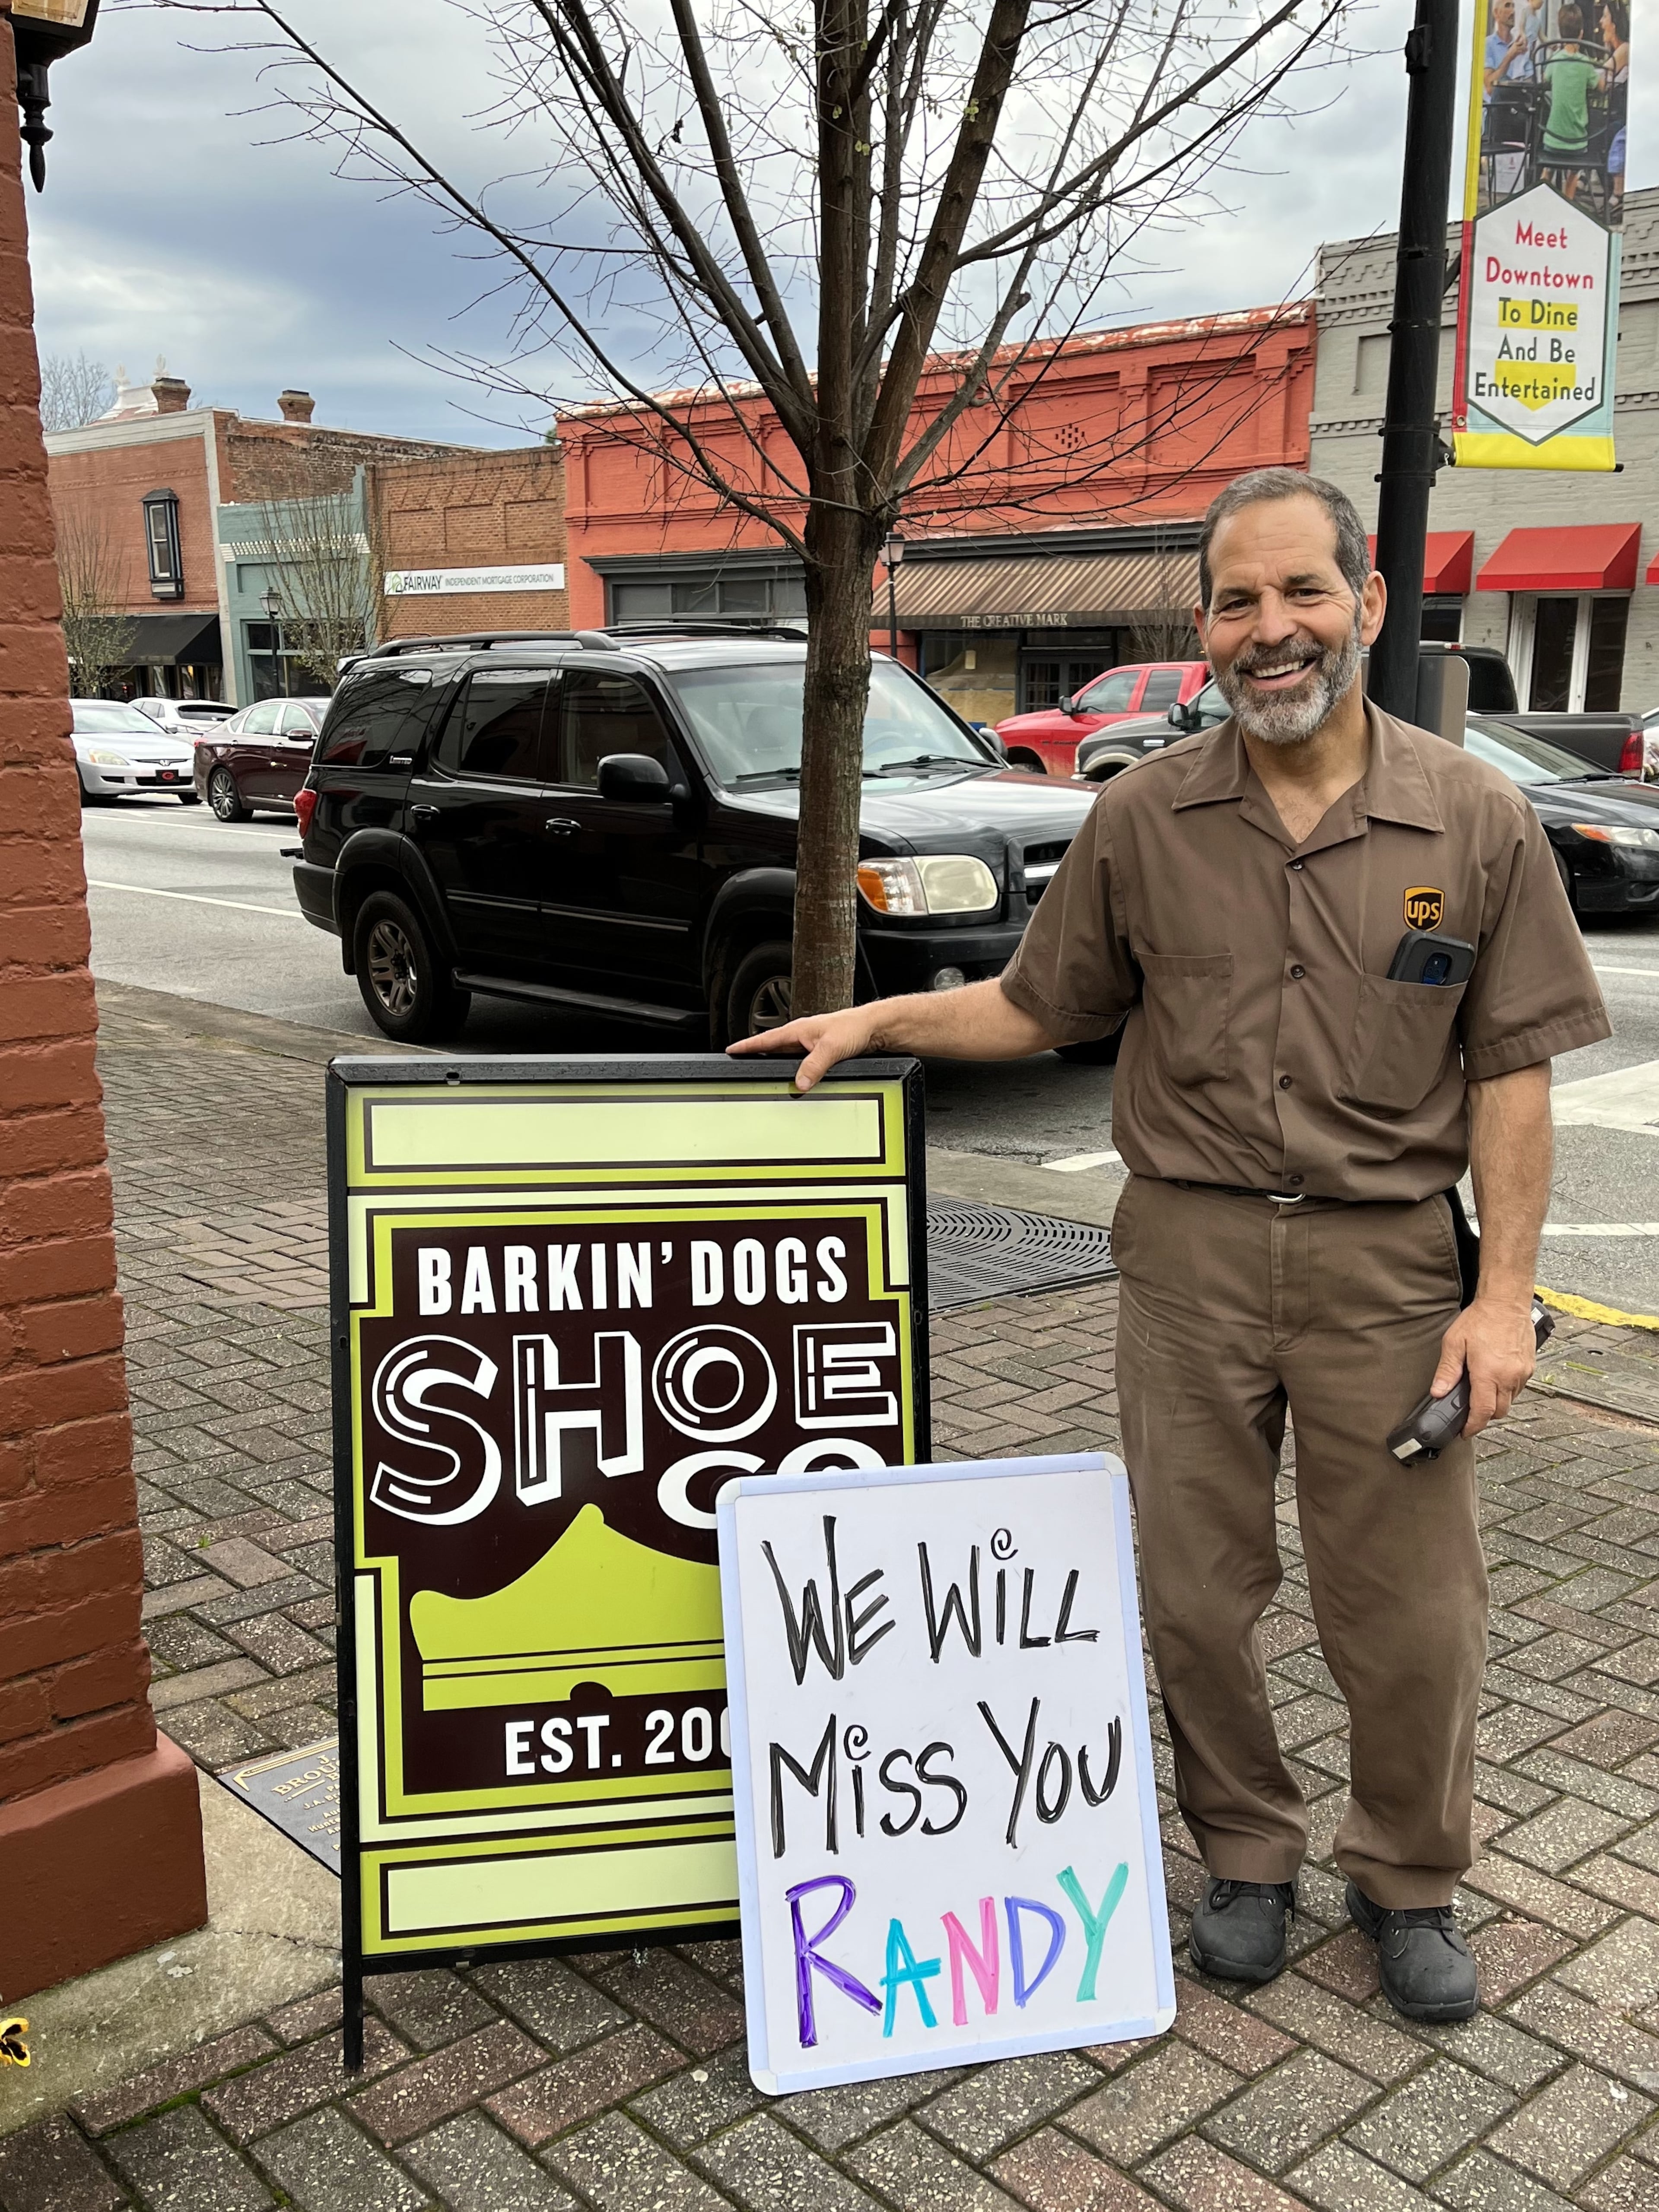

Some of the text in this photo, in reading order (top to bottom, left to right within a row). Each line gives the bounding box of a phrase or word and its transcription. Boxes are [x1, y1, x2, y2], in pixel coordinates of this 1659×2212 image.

[1516, 220, 1567, 249] Meet
[1486, 257, 1593, 289] Downtown
[1499, 297, 1577, 326] To Dine
[1497, 334, 1575, 363] And Be
[1475, 372, 1595, 401] Entertained
[404, 574, 554, 590] FAIRWAY INDEPENDENT MORTGAGE CORPORATION
[960, 613, 1068, 628] THE CREATIVE MARK
[1407, 900, 1440, 927] ups
[418, 1236, 848, 1315] BARKIN' DOGS
[369, 1321, 899, 1526] SHOE
[505, 1715, 622, 1776] EST.
[976, 1696, 1122, 1850] YOU
[785, 1862, 1129, 2048] RANDY
